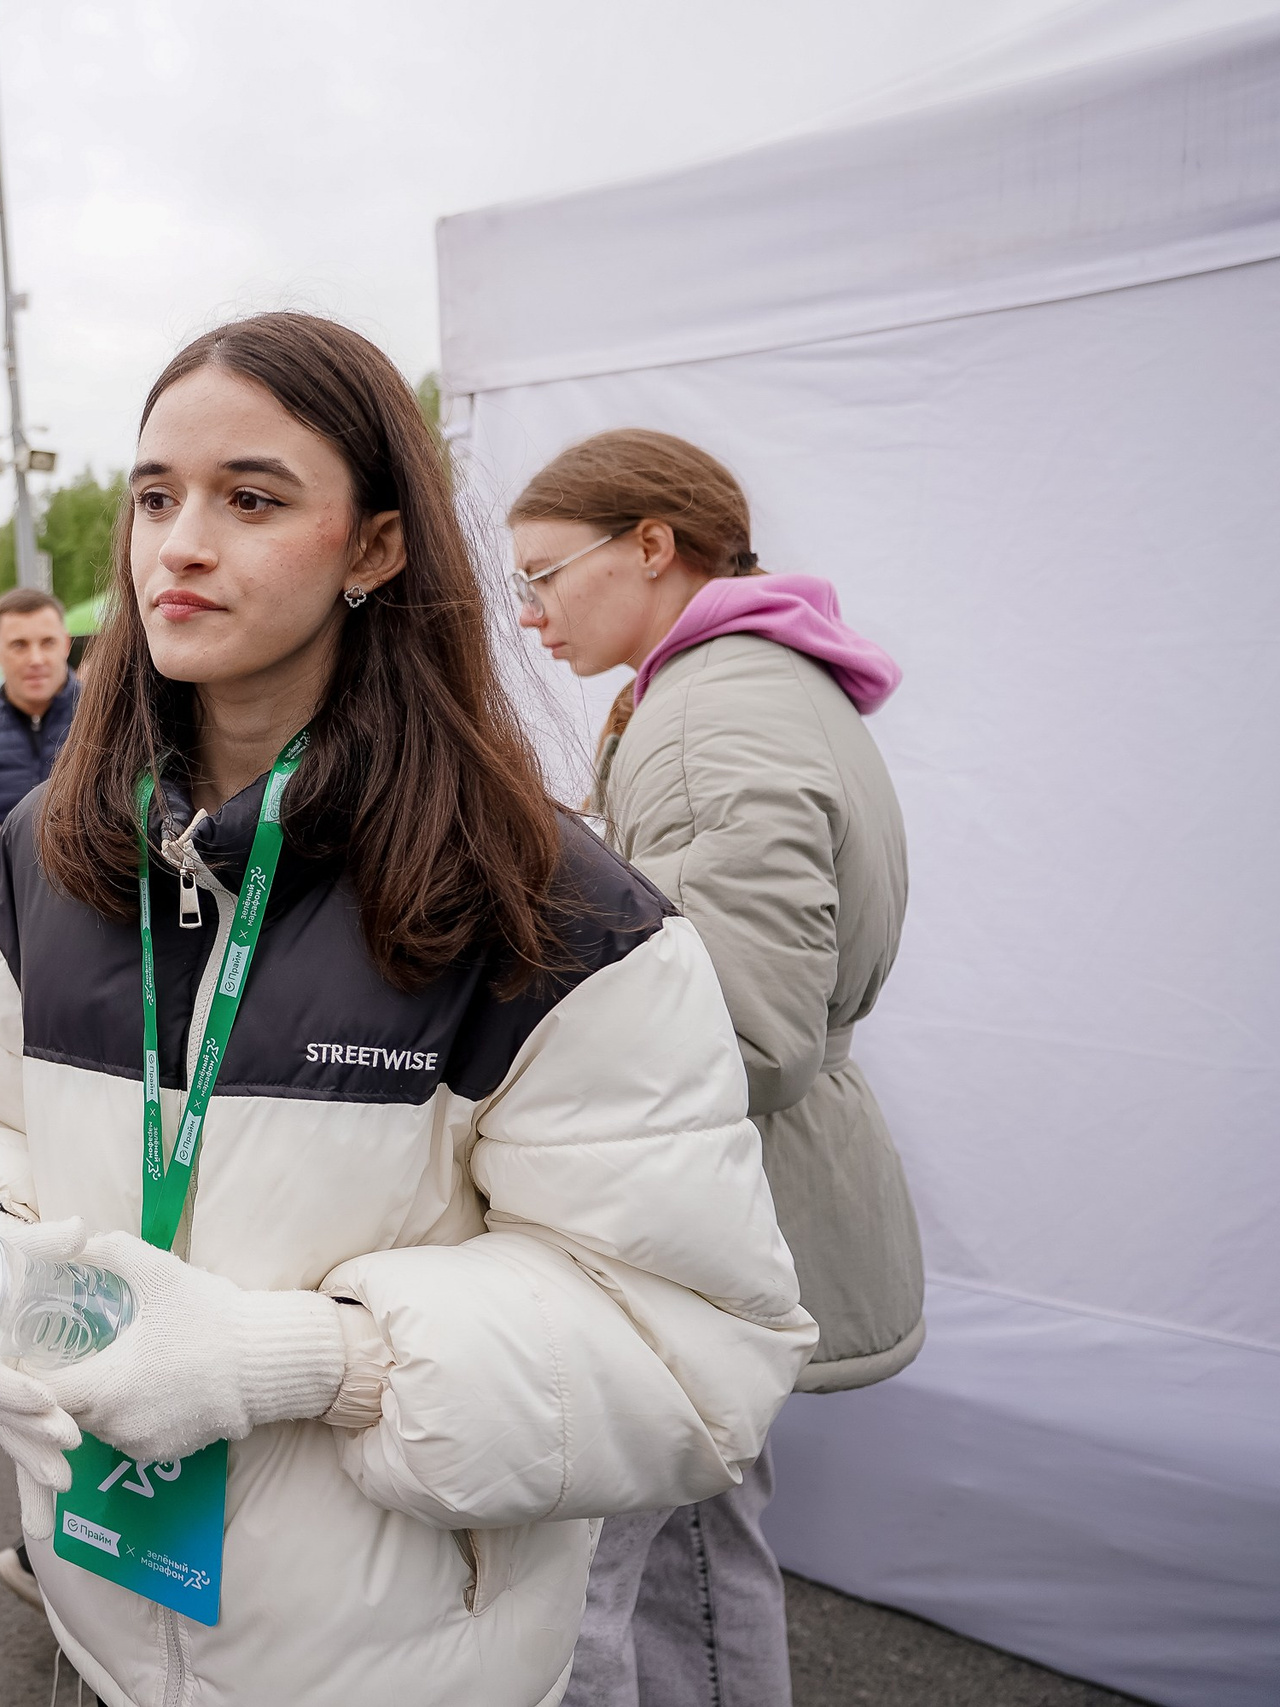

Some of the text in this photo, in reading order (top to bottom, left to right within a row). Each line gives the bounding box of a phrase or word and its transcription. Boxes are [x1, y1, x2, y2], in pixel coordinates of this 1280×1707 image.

[240, 883, 255, 920] зелёный
[248, 889, 262, 927] марафон
[228, 951, 243, 981] Прайм
[305, 1042, 439, 1071] STREETWISE
[148, 1065, 156, 1095] Прайм
[182, 1120, 196, 1150] Прайм
[79, 1524, 112, 1547] Прайм
[140, 1557, 184, 1582] марафон
[146, 1550, 189, 1574] зелёный
